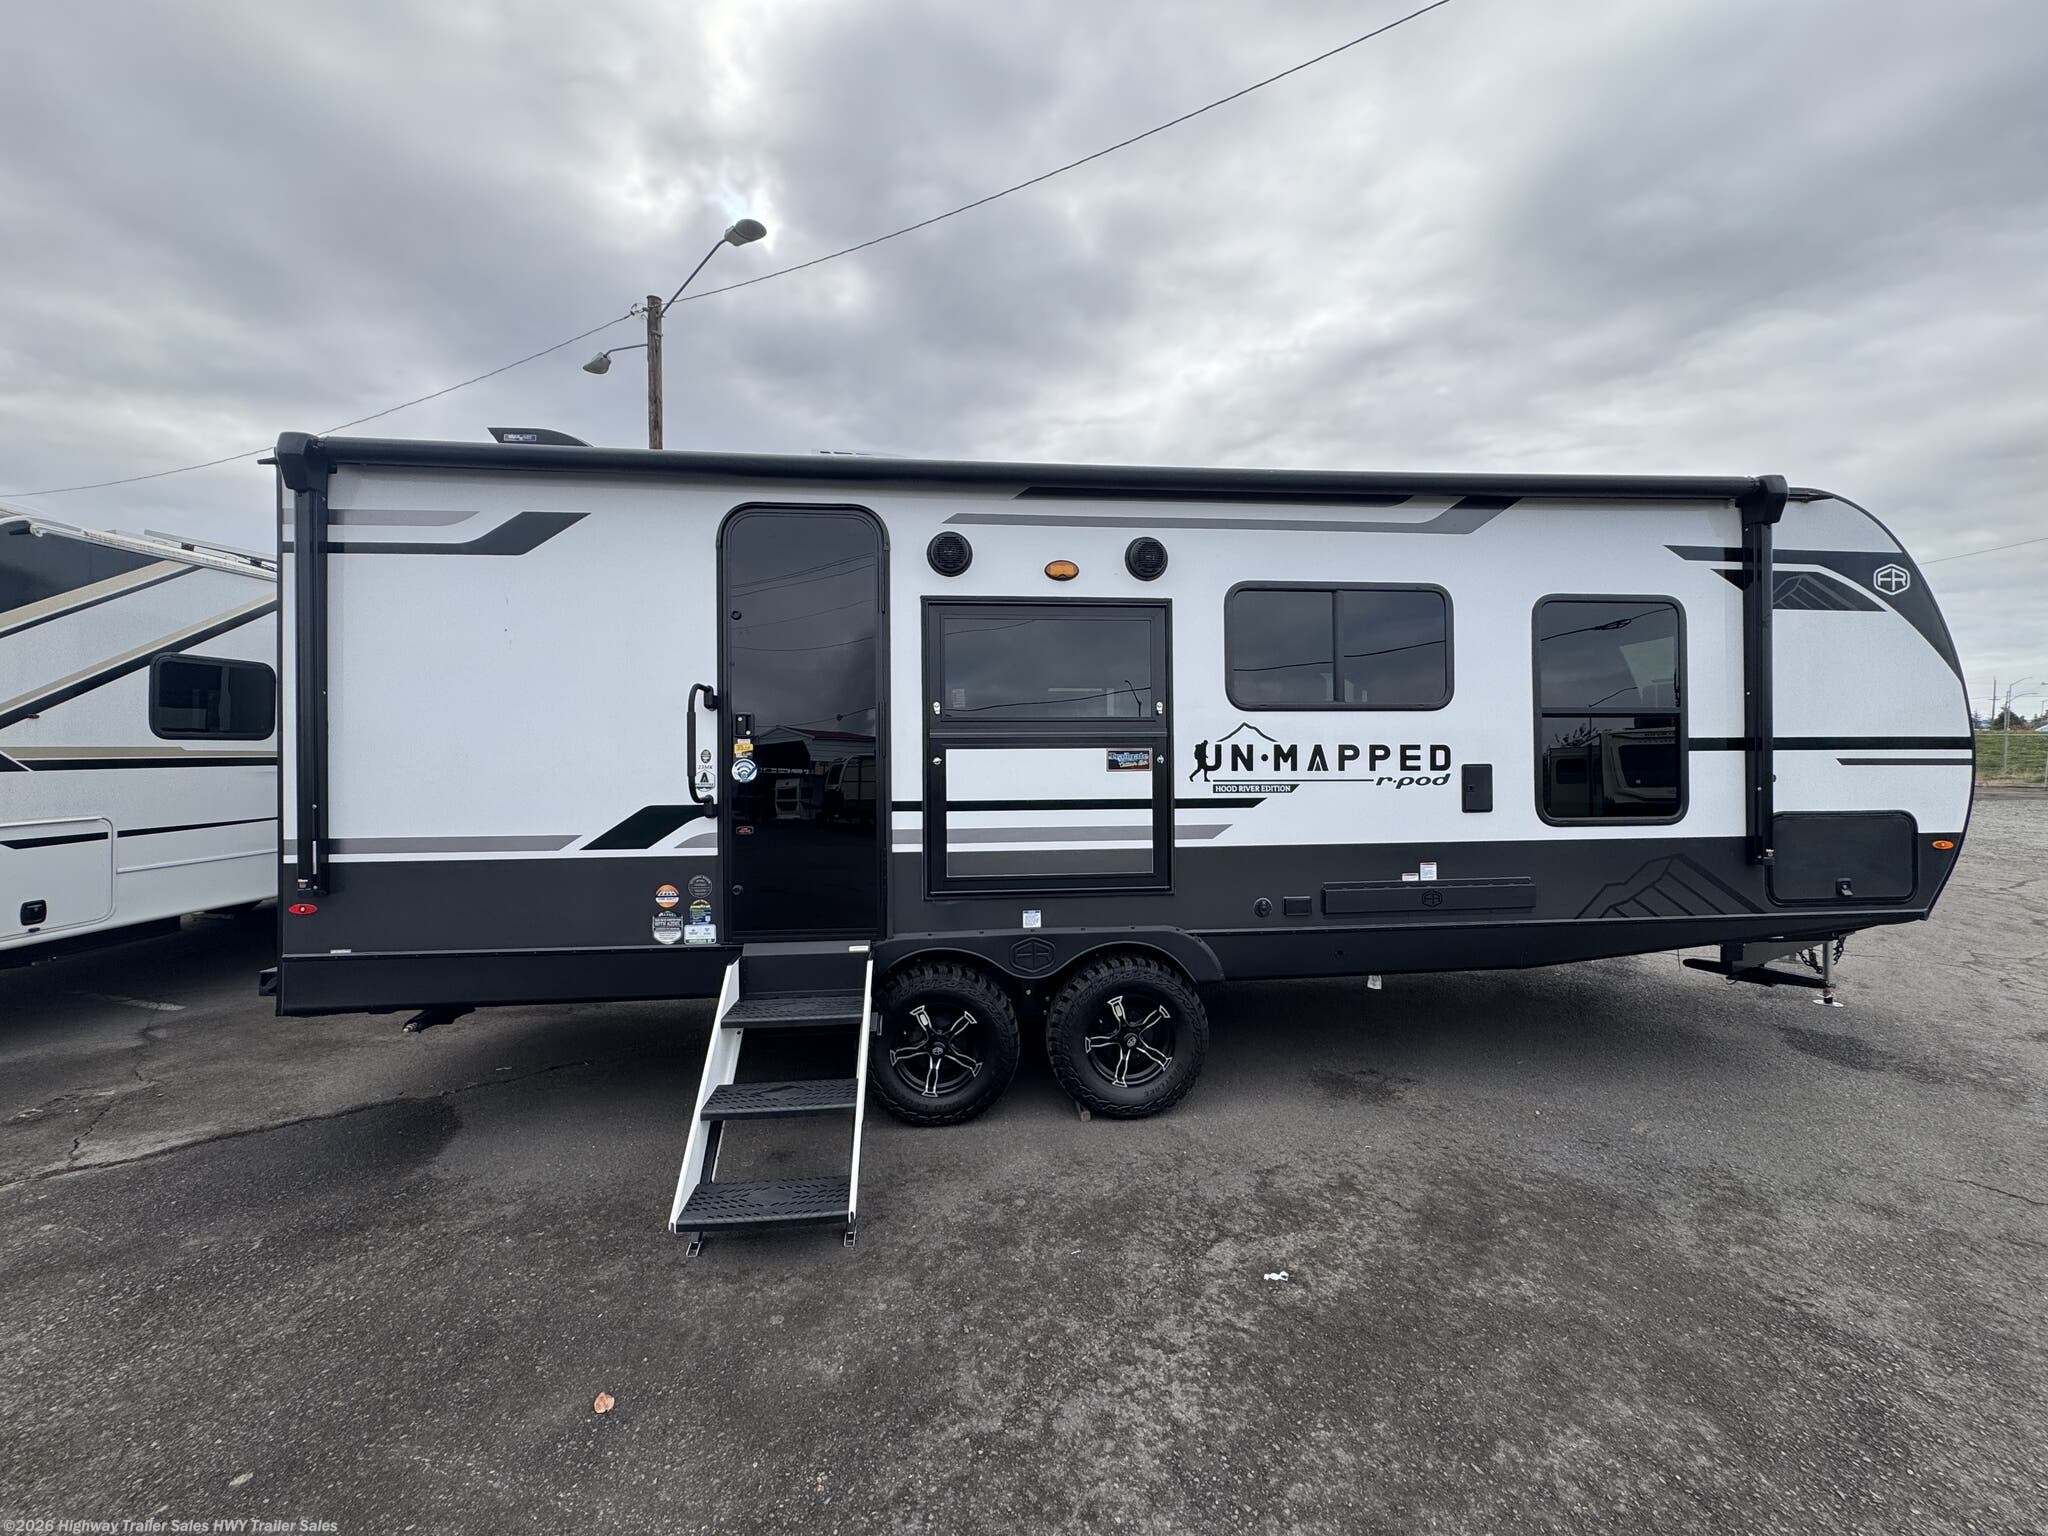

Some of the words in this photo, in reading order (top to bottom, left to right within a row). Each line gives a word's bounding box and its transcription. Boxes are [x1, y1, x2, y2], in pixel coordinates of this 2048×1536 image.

[1215, 784, 1238, 793] HOOD
[1238, 784, 1260, 793] RIVER
[1260, 784, 1291, 793] EDITION
